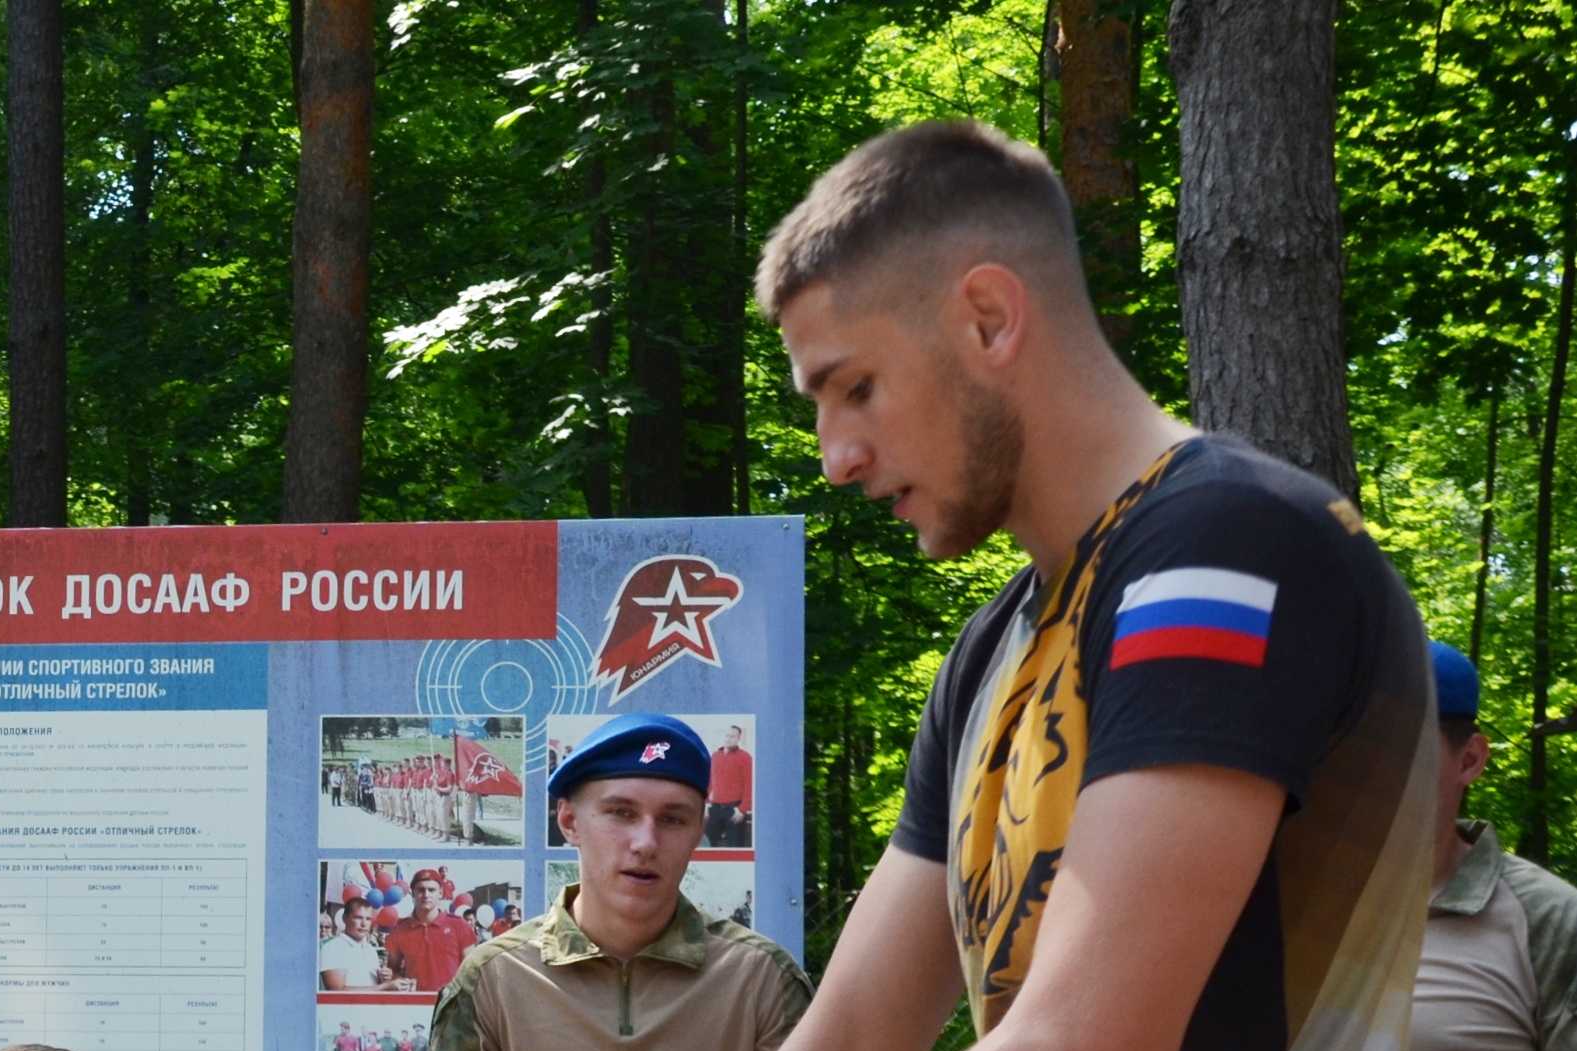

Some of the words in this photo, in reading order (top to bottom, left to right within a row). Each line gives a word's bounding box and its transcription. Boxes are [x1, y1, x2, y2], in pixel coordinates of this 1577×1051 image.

[61, 572, 250, 619] ДОСААФ
[281, 569, 463, 612] РОССИИ
[28, 658, 145, 676] СПОРТИВНОГО
[149, 658, 215, 675] ЗВАНИЯ
[630, 642, 680, 681] ЮНАРМИЯ
[86, 682, 167, 700] СТРЕЛОК»
[23, 827, 59, 836] ДОСААФ
[62, 827, 97, 835] РОССИИ
